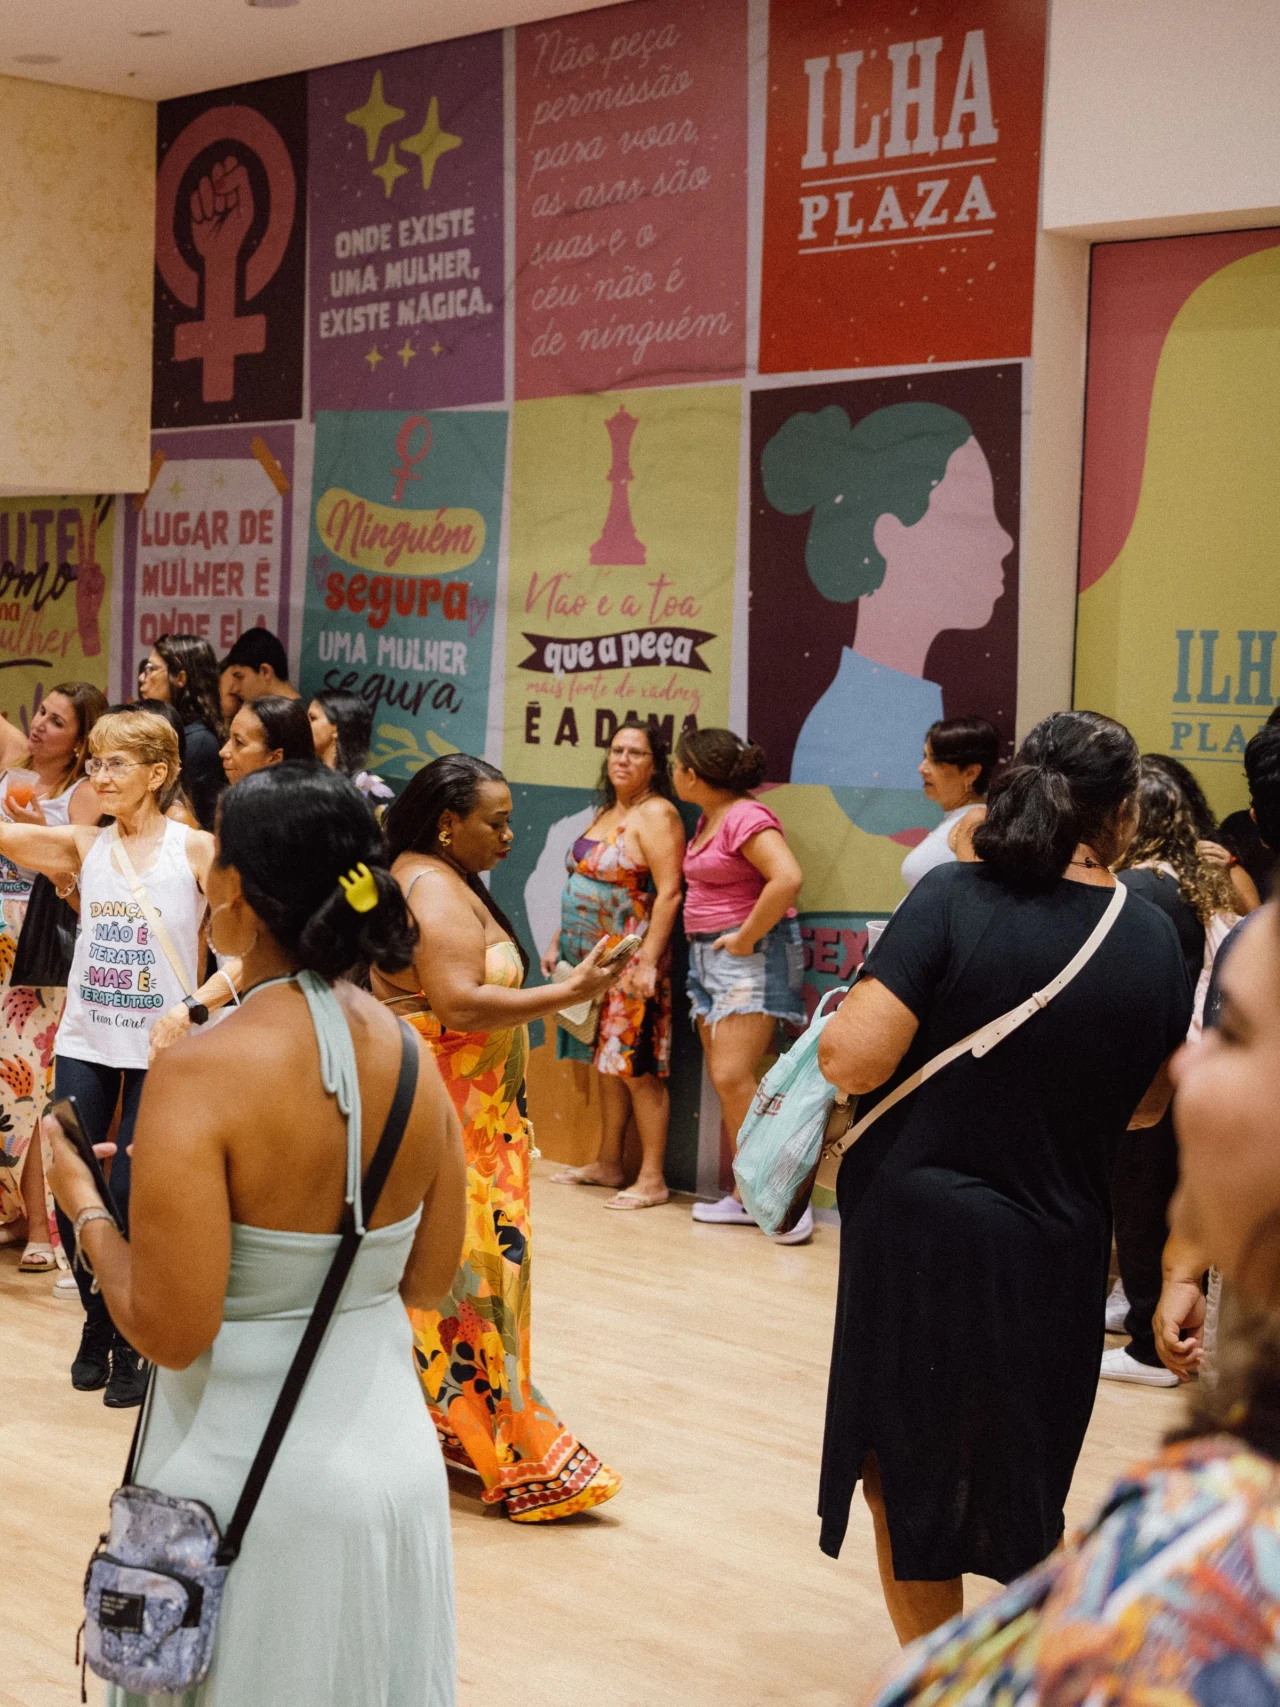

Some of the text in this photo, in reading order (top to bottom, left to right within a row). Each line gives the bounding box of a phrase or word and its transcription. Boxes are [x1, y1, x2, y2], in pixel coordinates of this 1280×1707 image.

[533, 24, 680, 79] Não peça
[527, 65, 694, 143] permissão
[801, 29, 998, 169] ILHA
[528, 136, 608, 190] para
[532, 159, 711, 218] as asas são
[798, 175, 997, 241] PLAZA
[335, 207, 475, 259] ONDE EXISTE
[529, 224, 657, 265] suas e o
[331, 248, 481, 297] UMA MULHER,
[532, 257, 685, 311] céu não é
[319, 301, 390, 339] EXISTE
[531, 305, 732, 365] de ninguém
[141, 508, 273, 550] LUGAR DE
[326, 498, 476, 567] Ninguém
[142, 558, 244, 597] MULHER
[325, 571, 469, 630] segura
[648, 573, 702, 626] toa
[318, 630, 467, 676] UMA MULHER
[544, 631, 693, 678] que a peça
[1173, 630, 1280, 706] ILH
[555, 707, 580, 747] A
[1170, 721, 1266, 753] PLA
[90, 901, 161, 923] DANÇA
[95, 921, 148, 945] NÃO É
[89, 942, 156, 965] TERAPIA
[80, 985, 164, 1009] TERAPÊUTICO
[89, 966, 150, 992] MAS É
[89, 1009, 146, 1029] Team Carol
